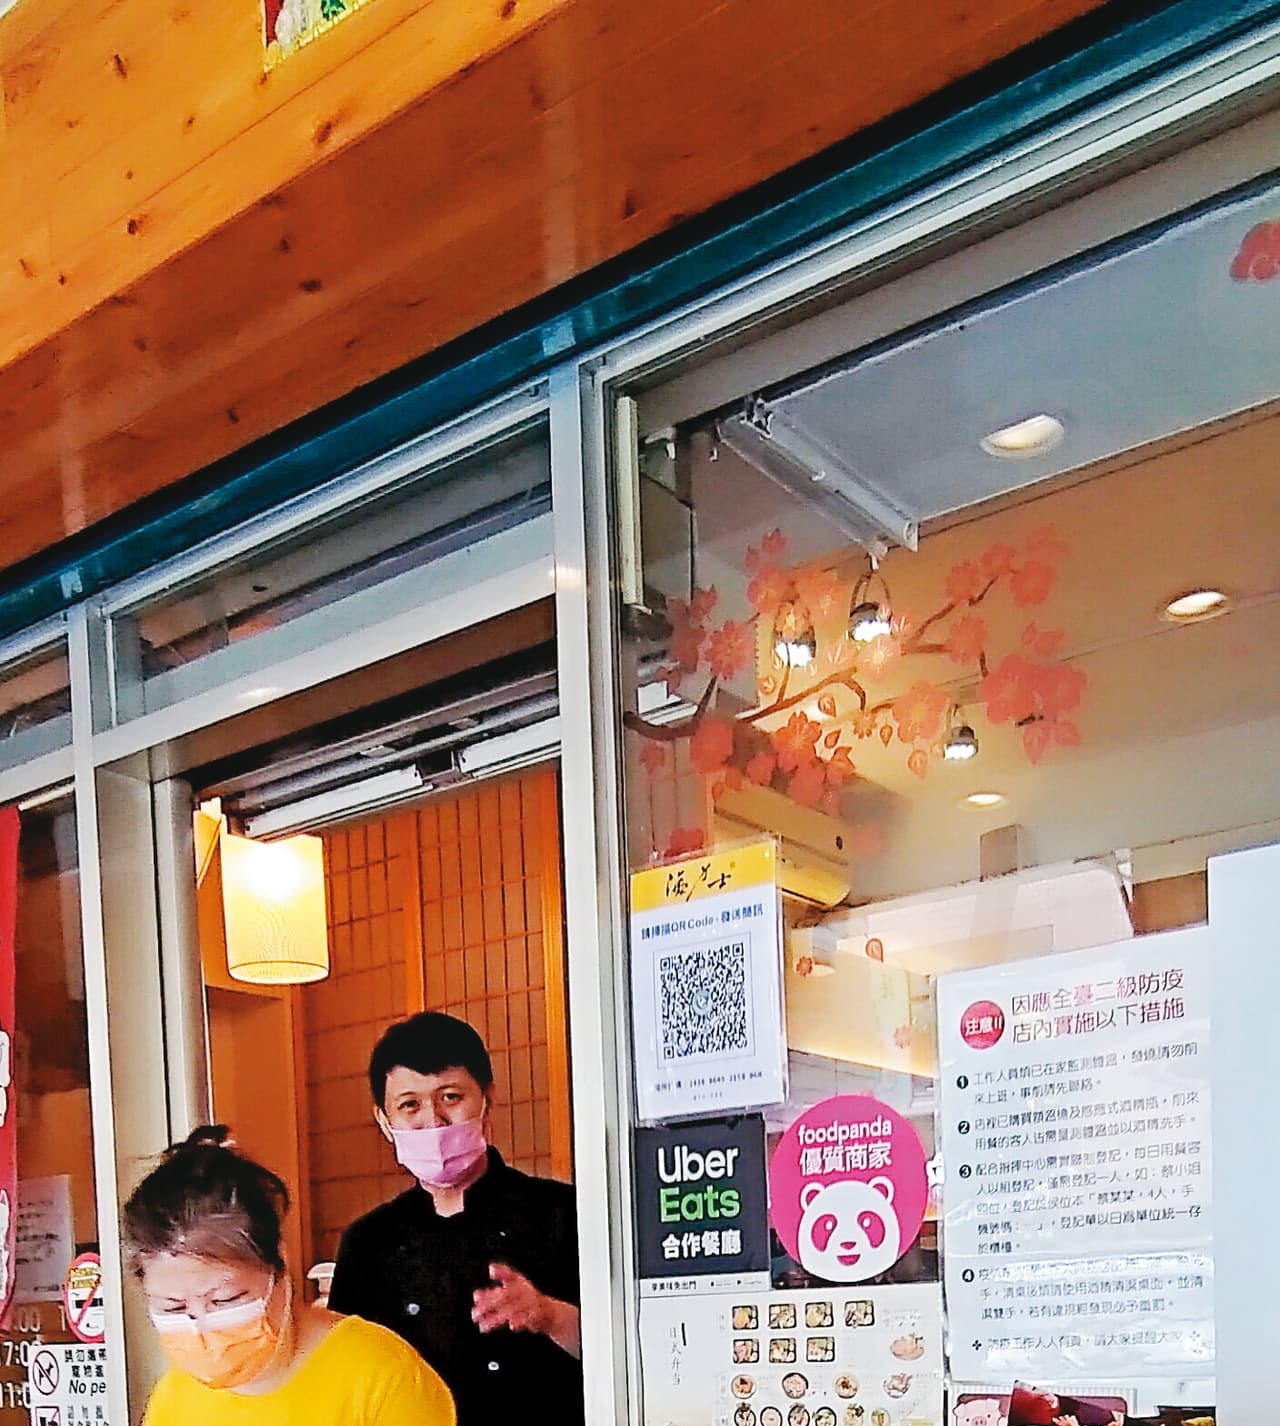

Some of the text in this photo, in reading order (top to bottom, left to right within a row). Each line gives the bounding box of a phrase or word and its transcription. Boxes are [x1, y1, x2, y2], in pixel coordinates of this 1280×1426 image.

[1012, 997, 1185, 1044] 店內實施以下措施
[798, 1115, 892, 1146] foodpanda
[657, 1146, 738, 1184] Uber
[800, 1141, 892, 1176] 優質商家
[660, 1186, 741, 1223] Eats
[661, 1230, 742, 1259] 合作餐廳
[69, 1379, 87, 1394] No
